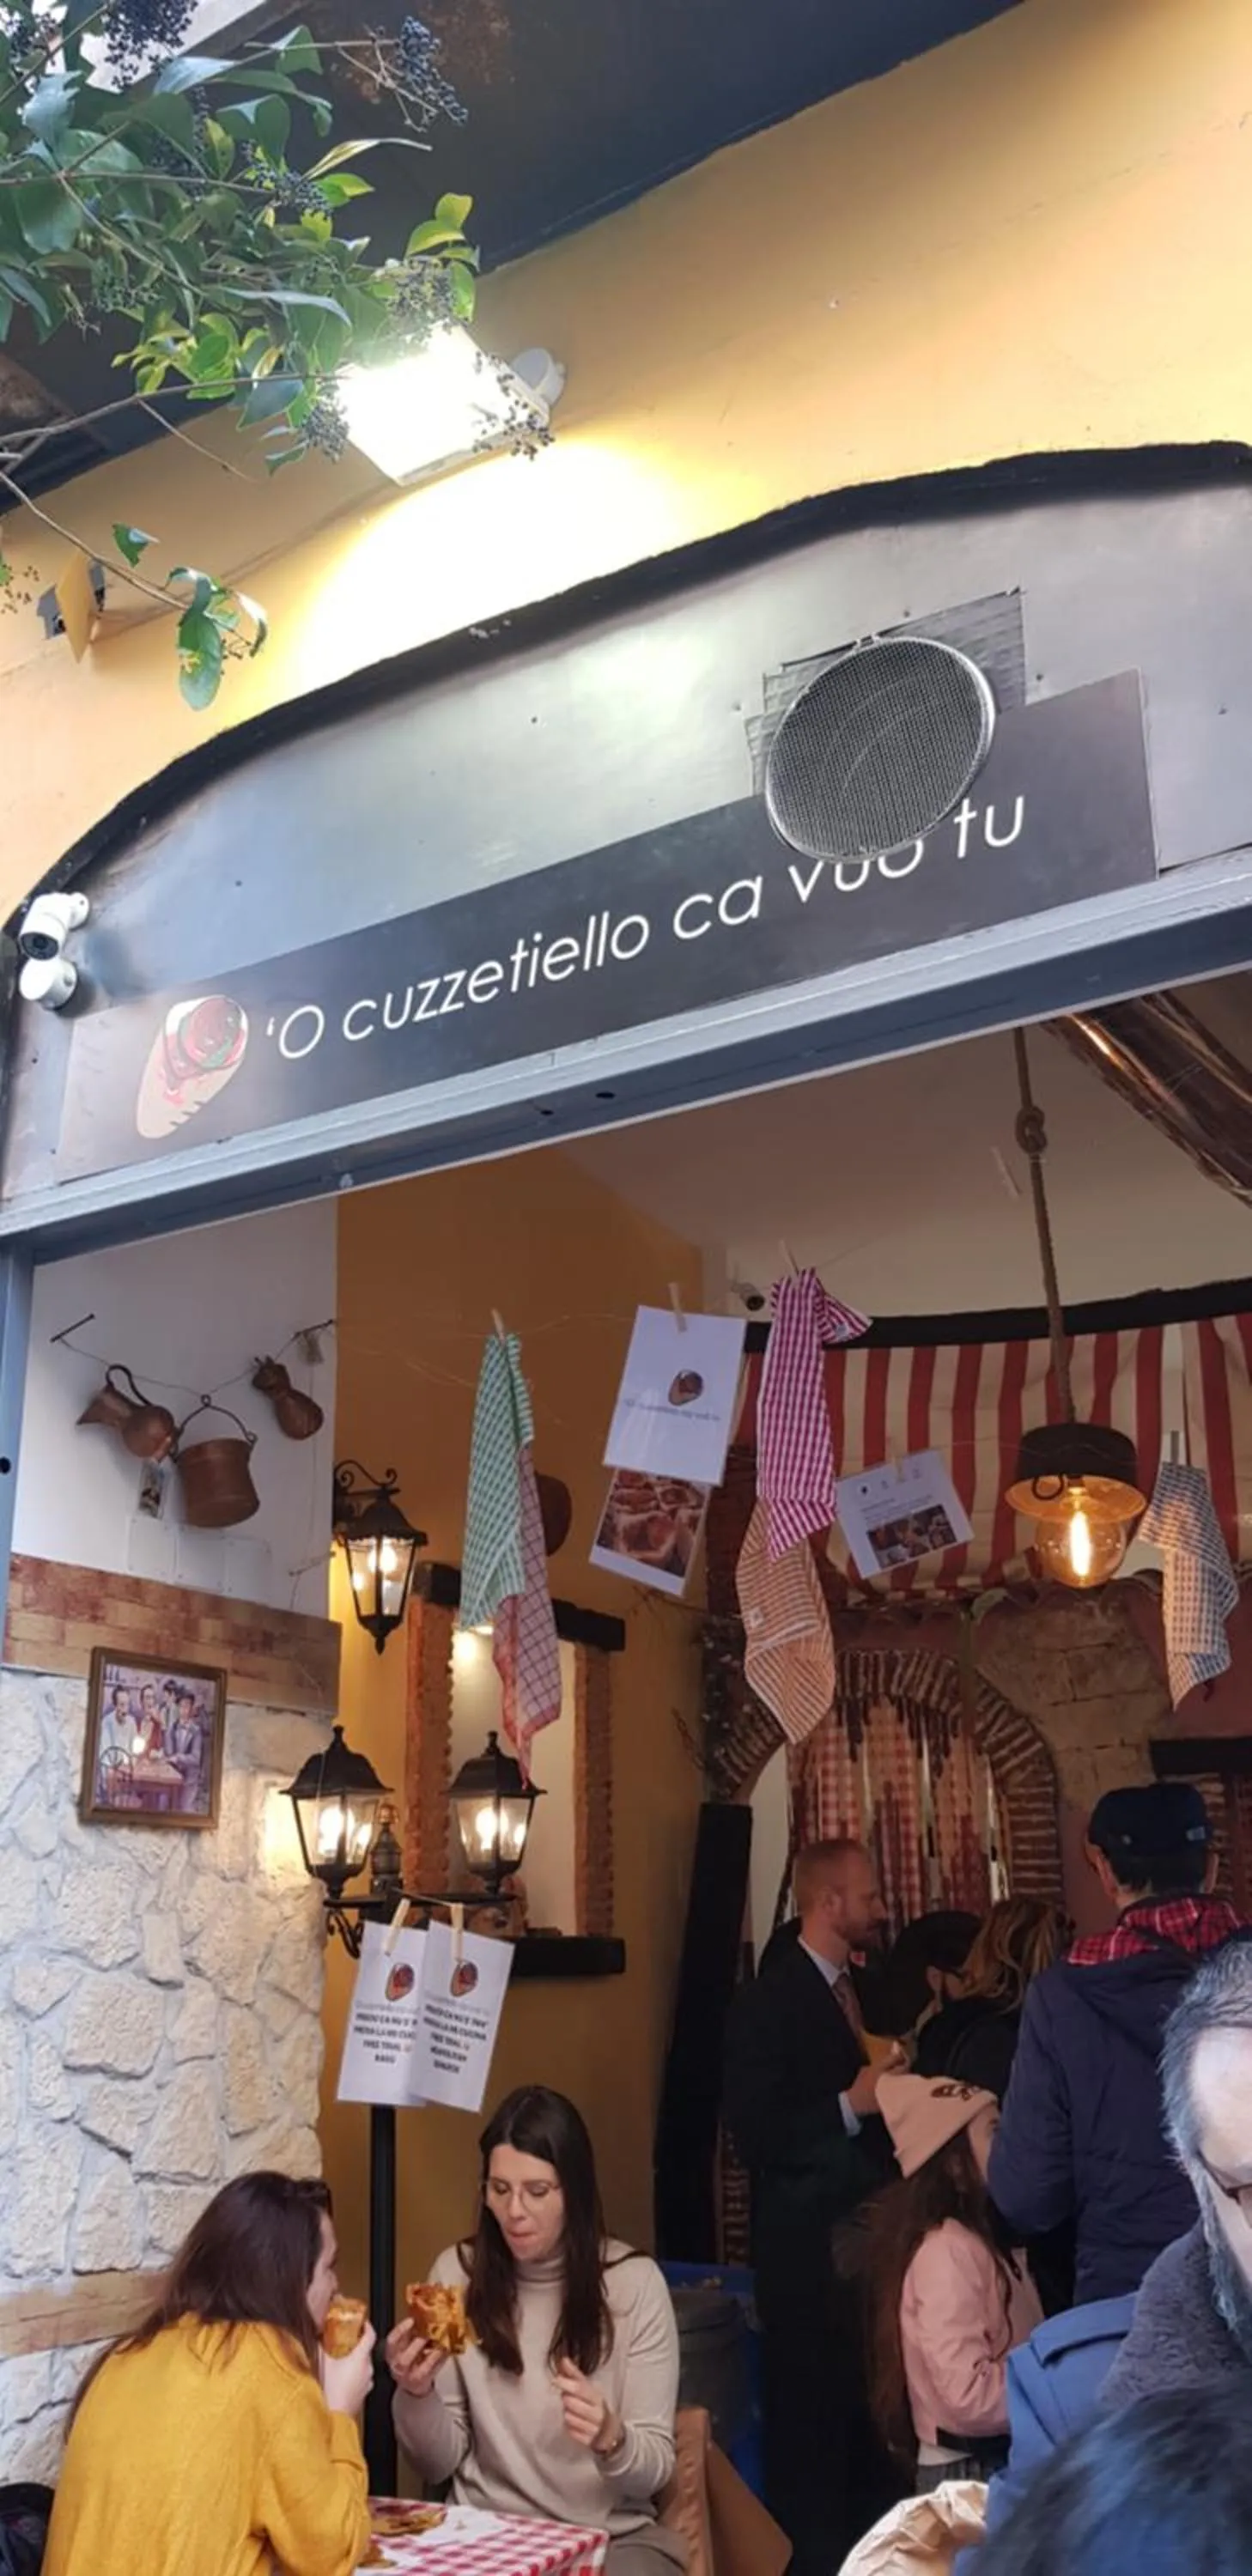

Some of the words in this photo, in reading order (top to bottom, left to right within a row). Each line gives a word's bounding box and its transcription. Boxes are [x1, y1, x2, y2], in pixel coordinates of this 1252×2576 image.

[343, 911, 650, 1042] cuzzetiello
[672, 874, 763, 939] ca
[953, 795, 1024, 859] tu
